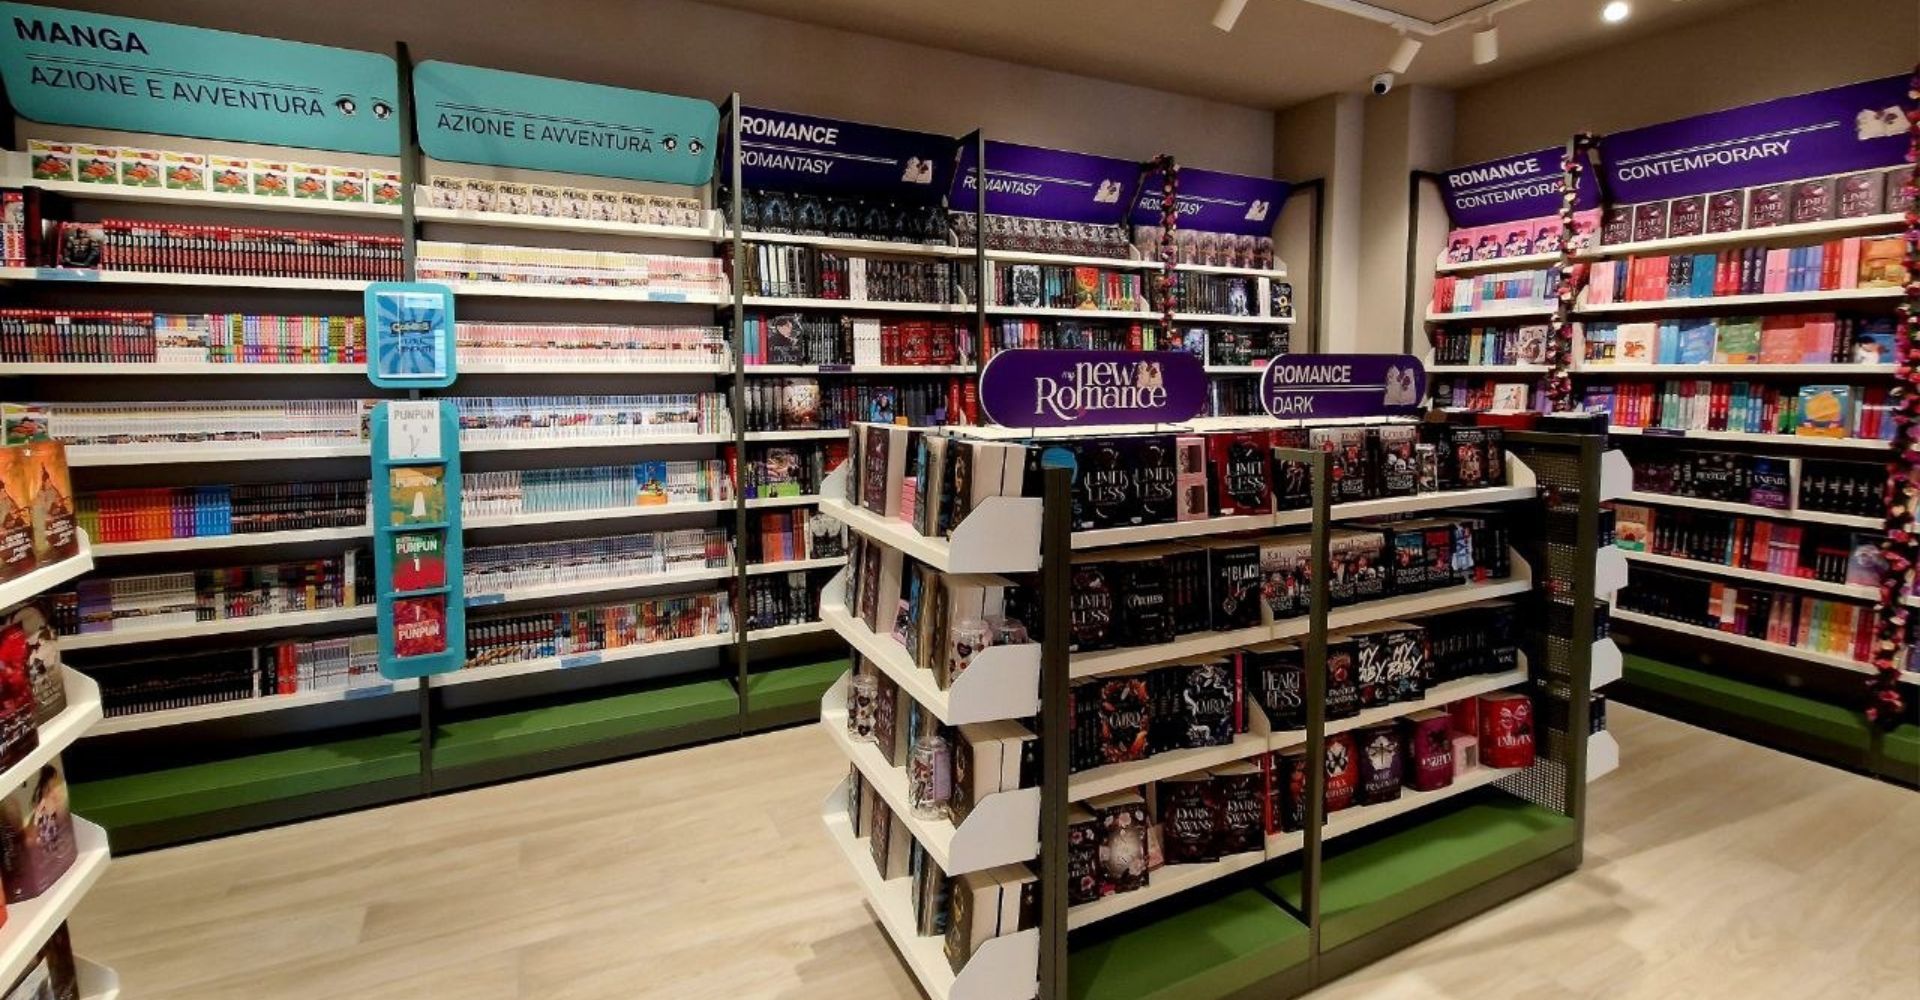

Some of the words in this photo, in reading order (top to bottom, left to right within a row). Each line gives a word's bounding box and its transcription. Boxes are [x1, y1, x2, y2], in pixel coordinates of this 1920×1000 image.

[13, 17, 148, 56] MANGA
[31, 67, 138, 97] AZIONE
[147, 79, 165, 100] E
[173, 84, 325, 119] AVVENTURA
[437, 113, 515, 138] AZIONE
[524, 124, 535, 142] E
[541, 128, 652, 154] AVVENTURA
[740, 116, 840, 146] ROMANCE
[740, 150, 834, 175] ROMANTASY
[1448, 158, 1541, 188] ROMANCE
[1617, 140, 1791, 188] CONTEMPORARY
[1076, 361, 1137, 386] new
[1273, 364, 1350, 390] ROMANCE
[1035, 377, 1168, 420] Romance
[1273, 396, 1313, 416] DARK
[396, 541, 438, 554] PUNPUN
[414, 558, 420, 572] 1
